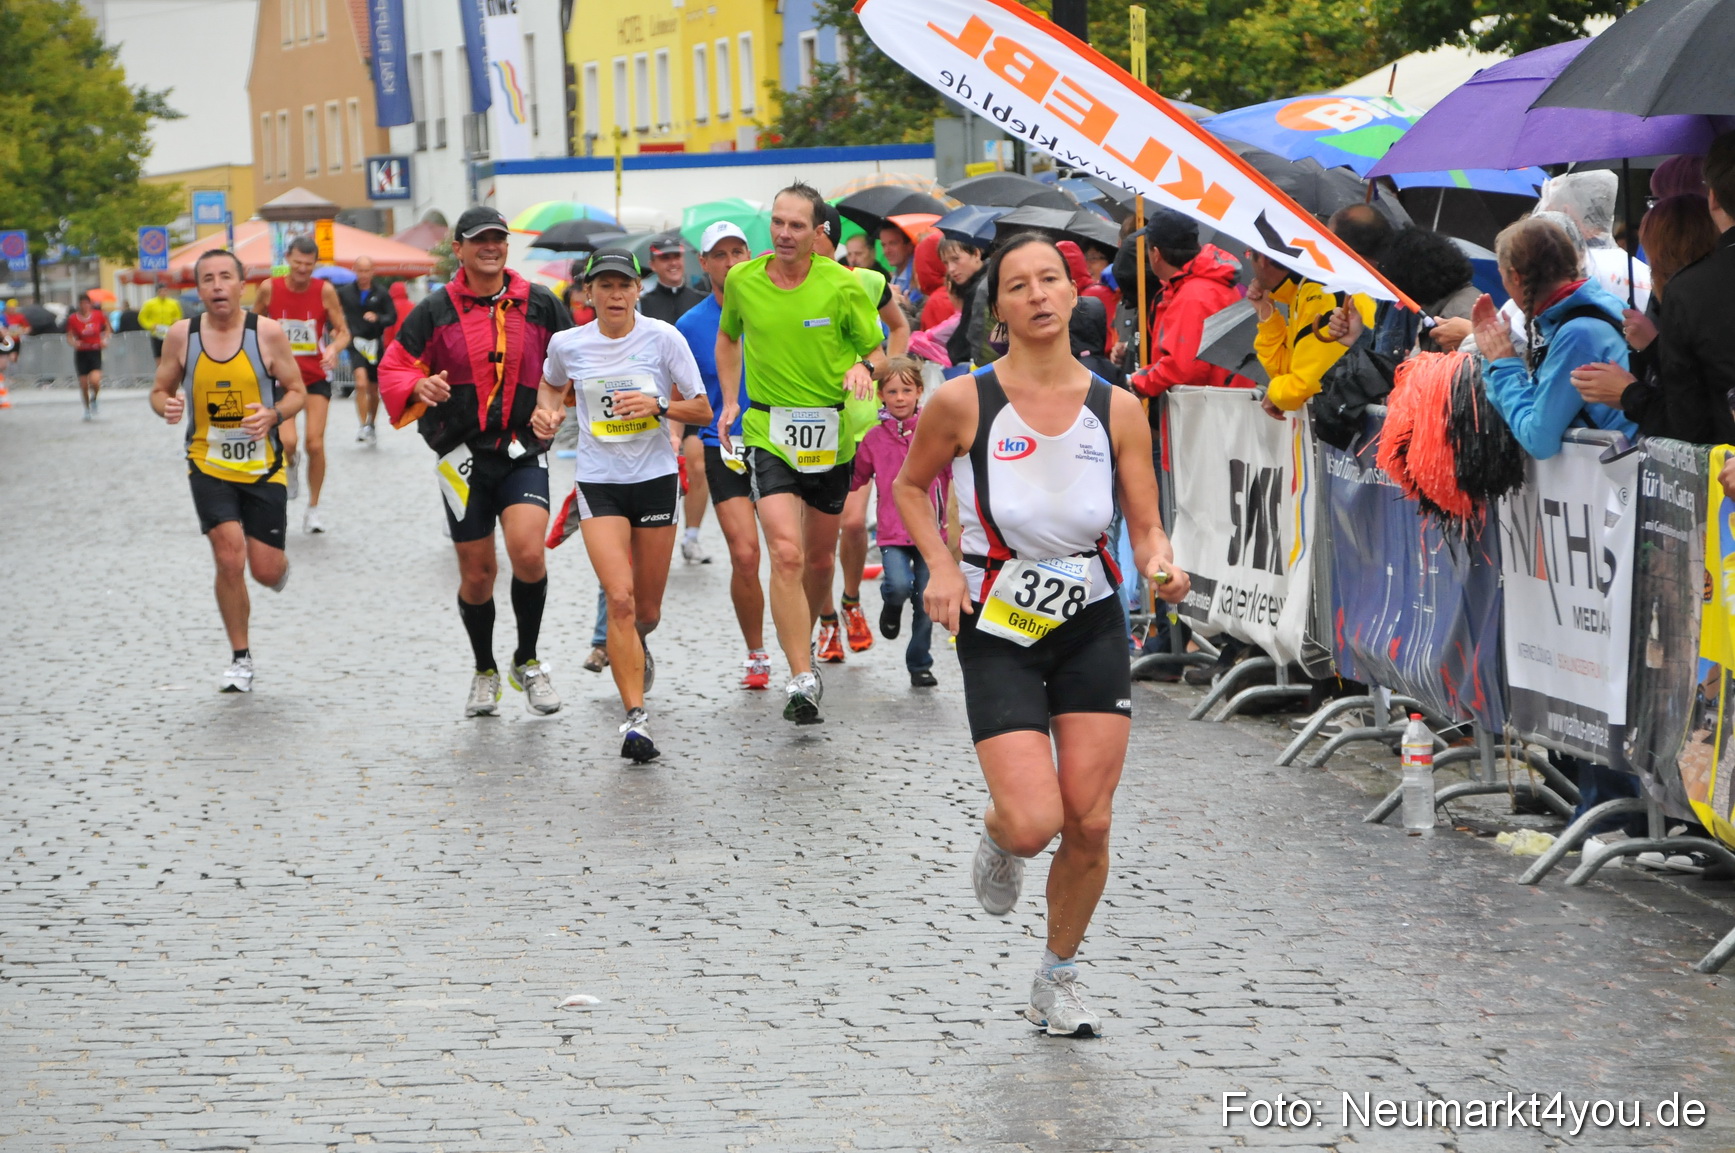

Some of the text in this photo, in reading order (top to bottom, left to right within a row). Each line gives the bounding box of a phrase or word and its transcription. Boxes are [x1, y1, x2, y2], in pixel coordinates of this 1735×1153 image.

[606, 421, 648, 434] Christine
[785, 424, 826, 449] 307
[998, 438, 1026, 452] tkn
[1642, 468, 1660, 498] für
[650, 512, 671, 521] asics
[1014, 569, 1087, 620] 328
[1008, 612, 1055, 637] Gabri
